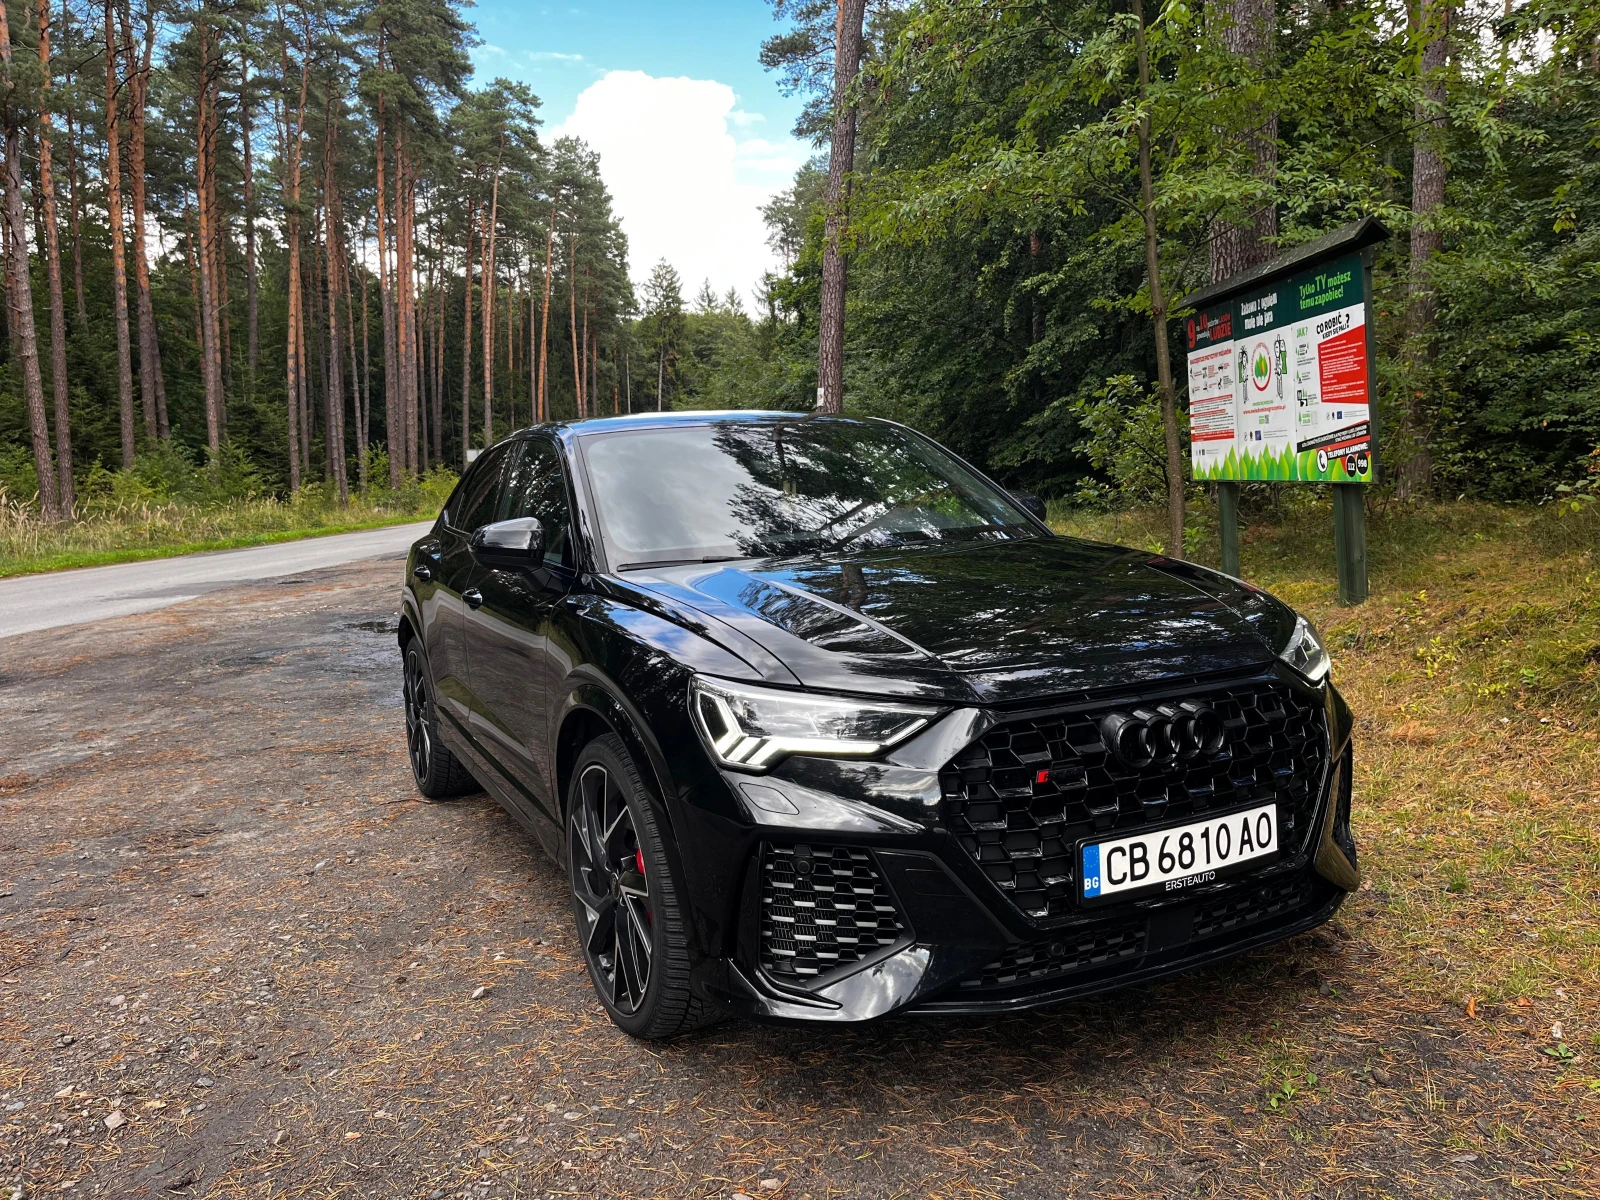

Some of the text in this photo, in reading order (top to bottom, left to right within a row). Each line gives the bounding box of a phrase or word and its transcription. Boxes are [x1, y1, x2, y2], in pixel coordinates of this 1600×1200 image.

[1299, 271, 1351, 299] Tylko TY możesz
[1300, 284, 1344, 310] temu zapobiec!
[1199, 313, 1208, 330] 10
[1209, 321, 1232, 341] LUDZIE
[1316, 322, 1325, 335] CO
[1324, 311, 1342, 331] ROBIĆ
[1187, 319, 1196, 348] 9
[1296, 326, 1309, 339] JAK?
[1326, 448, 1346, 459] TELEFONY
[1357, 459, 1367, 468] 998
[1347, 462, 1356, 471] 112
[1106, 811, 1272, 886] CB 6810 AO
[1084, 876, 1100, 891] BG
[1165, 870, 1216, 892] ERSTEAUTO
